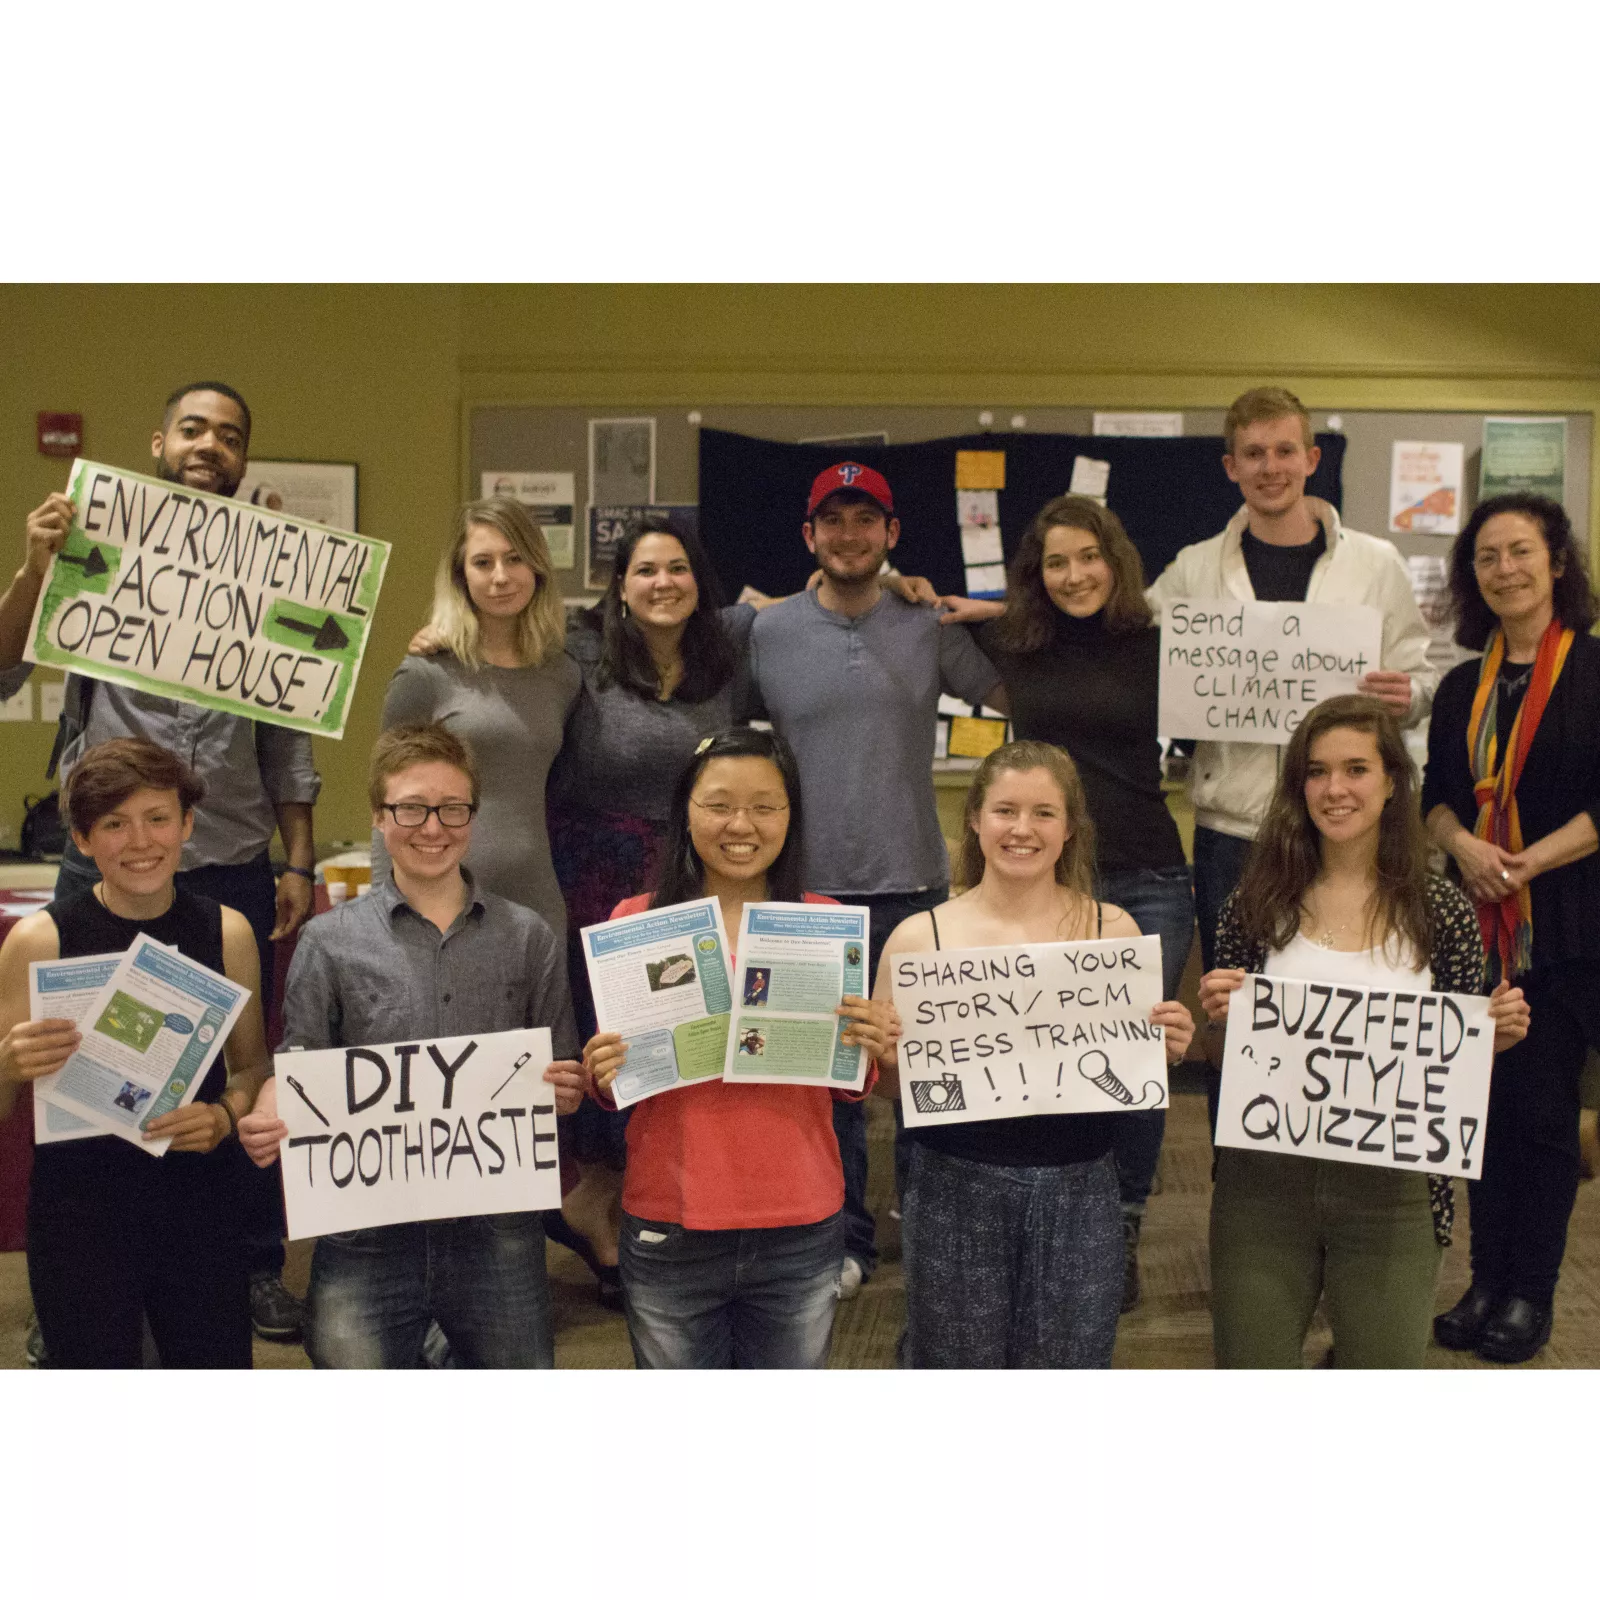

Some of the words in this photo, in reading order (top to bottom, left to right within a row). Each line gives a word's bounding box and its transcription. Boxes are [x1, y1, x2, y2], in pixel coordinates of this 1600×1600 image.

[84, 473, 368, 617] ENVIRONMENTAL
[111, 555, 264, 639] ACTION
[1171, 604, 1245, 638] Send
[1282, 615, 1301, 637] a
[57, 600, 172, 671] OPEN
[182, 632, 339, 718] HOUSE!
[1168, 645, 1279, 681] message
[1291, 648, 1368, 675] about
[1193, 675, 1317, 702] CLIMATE
[1206, 705, 1302, 734] CHANG
[898, 953, 1036, 988] SHARING
[1064, 947, 1142, 975] YOUR
[1057, 983, 1132, 1009] PCM
[903, 1032, 1014, 1069] PRESS
[1025, 1018, 1162, 1050] TRAINING
[1252, 977, 1481, 1064] BUZZFEED-
[345, 1040, 479, 1115] DIY
[1302, 1046, 1450, 1114] STYLE
[288, 1104, 557, 1189] TOOTHPASTE
[1241, 1093, 1478, 1170] QUIZZES!
